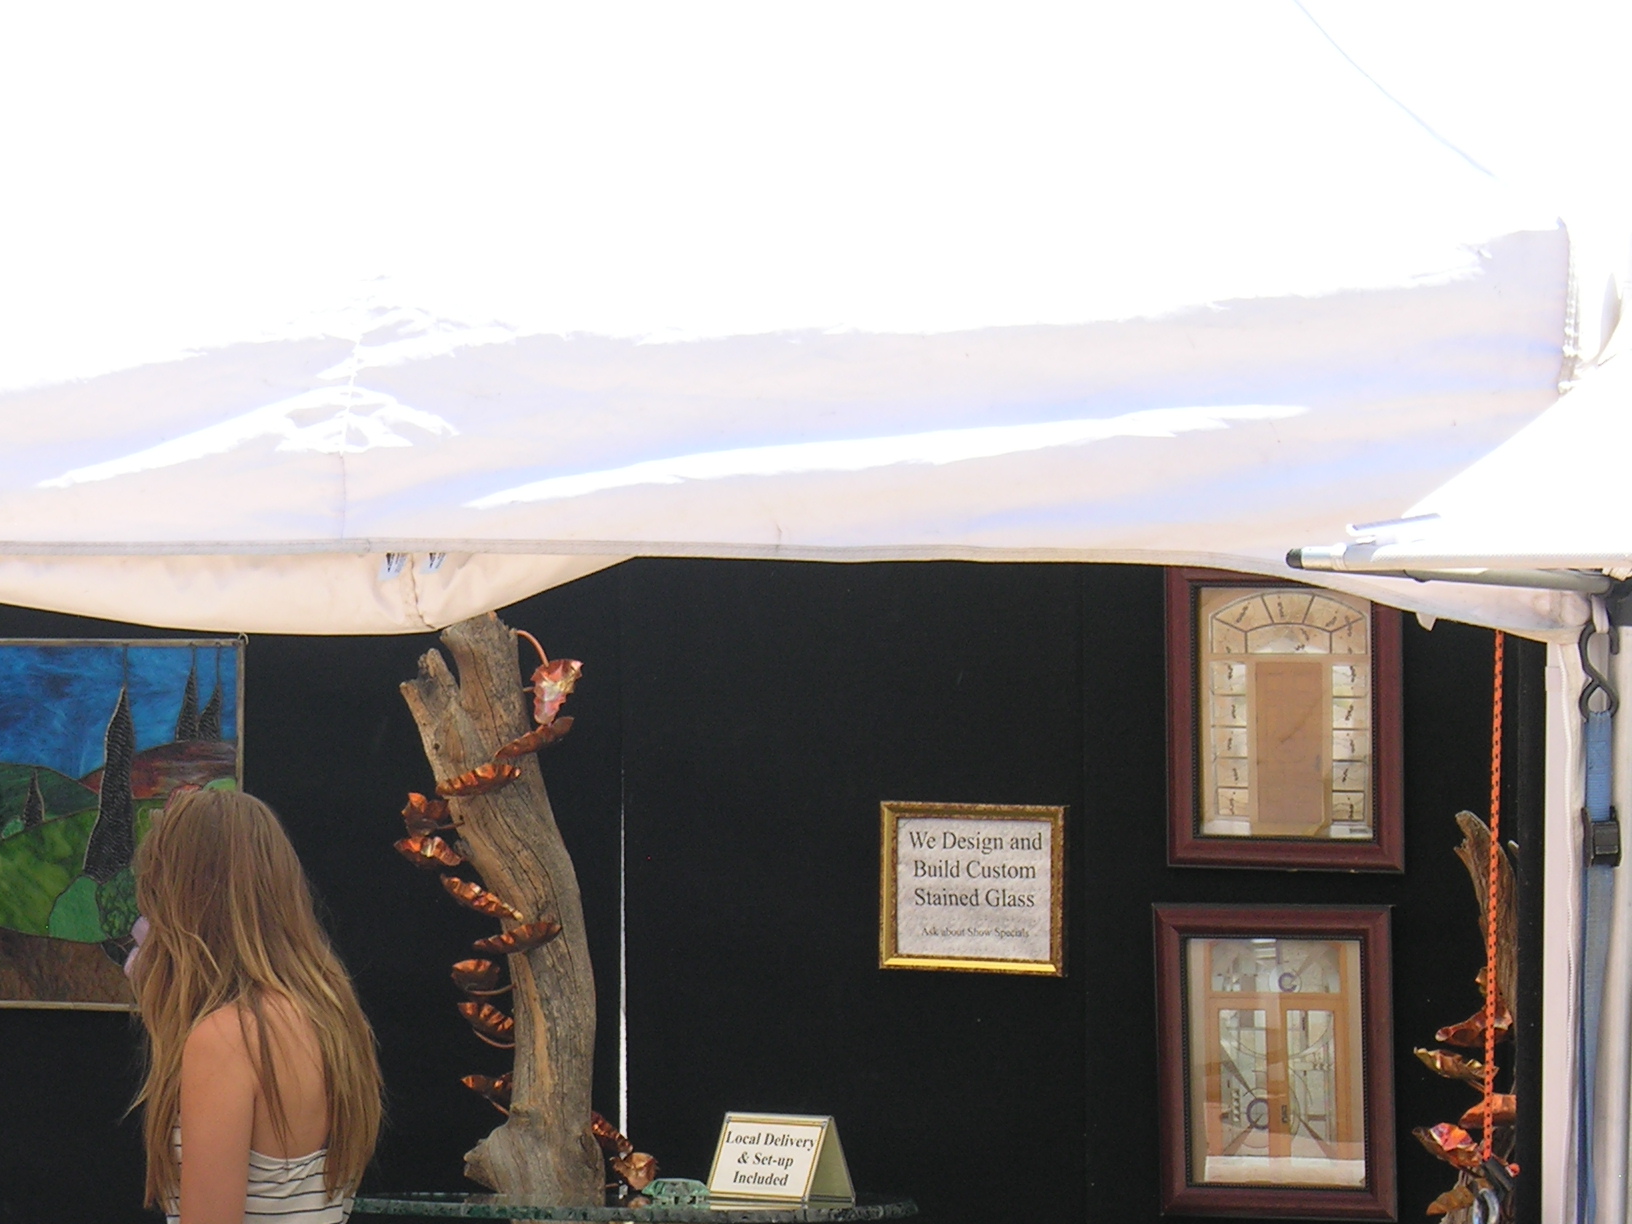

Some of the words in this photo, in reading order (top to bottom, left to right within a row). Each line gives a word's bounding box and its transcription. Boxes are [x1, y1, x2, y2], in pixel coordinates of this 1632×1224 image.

[909, 831, 936, 850] We
[942, 831, 1004, 855] Design
[1010, 832, 1043, 850] and
[913, 860, 960, 878] Build
[966, 860, 1036, 879] Custom
[914, 888, 980, 907] Stained
[985, 888, 1035, 908] Glass
[922, 926, 938, 937] Ask
[941, 926, 965, 937] about
[967, 927, 991, 937] Show
[995, 927, 1029, 939] Specials
[725, 1131, 761, 1146] Local
[764, 1132, 817, 1151] Delivery
[737, 1151, 749, 1165] &
[752, 1152, 794, 1170] Set-up
[733, 1170, 789, 1186] Included
